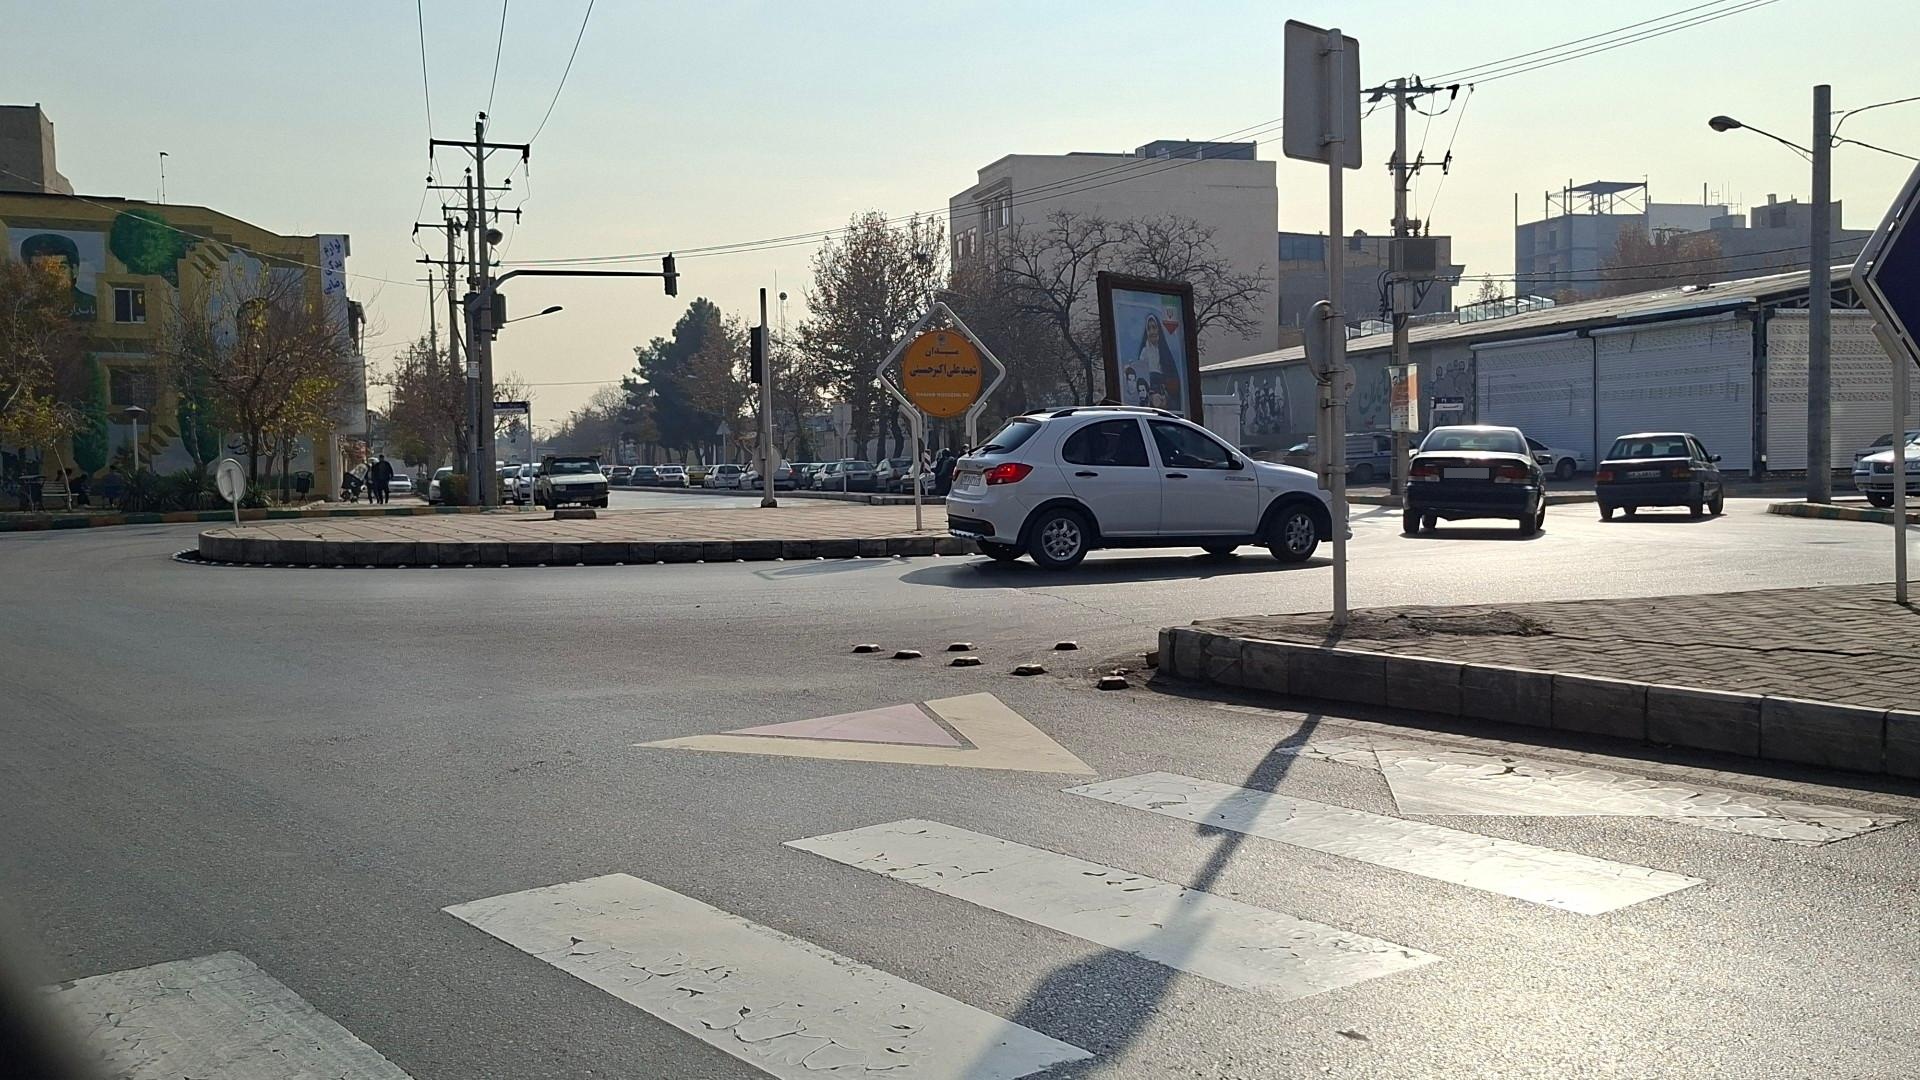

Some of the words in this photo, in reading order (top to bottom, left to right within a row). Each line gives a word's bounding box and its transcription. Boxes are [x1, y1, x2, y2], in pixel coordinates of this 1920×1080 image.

[323, 238, 341, 257] لوازم
[925, 347, 959, 357] میدان
[932, 363, 947, 378] اکبر
[947, 364, 961, 377] علی
[961, 365, 977, 377] شهید
